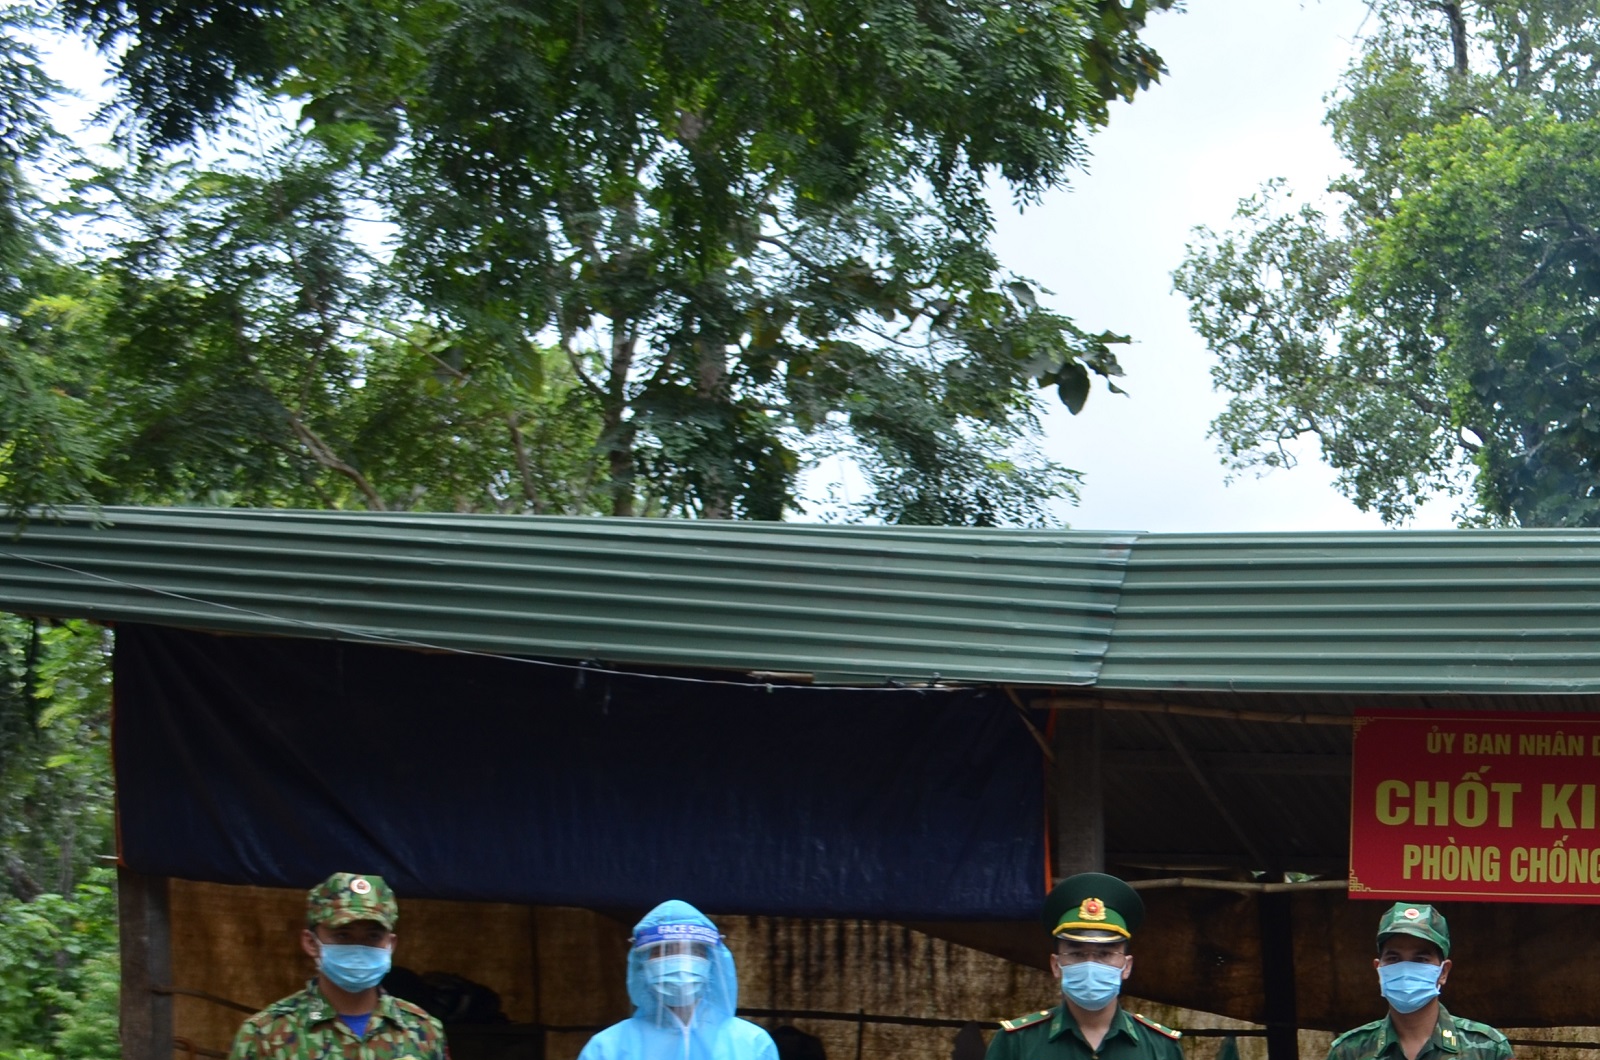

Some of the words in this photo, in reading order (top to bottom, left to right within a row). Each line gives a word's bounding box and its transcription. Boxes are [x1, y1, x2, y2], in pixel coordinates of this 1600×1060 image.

[1426, 725, 1456, 754] ỦY
[1462, 733, 1511, 755] BAN
[1519, 731, 1584, 756] NHÂN
[1375, 766, 1522, 828] CHỐT
[1403, 836, 1501, 882] PHÒNG
[657, 924, 687, 935] FACE
